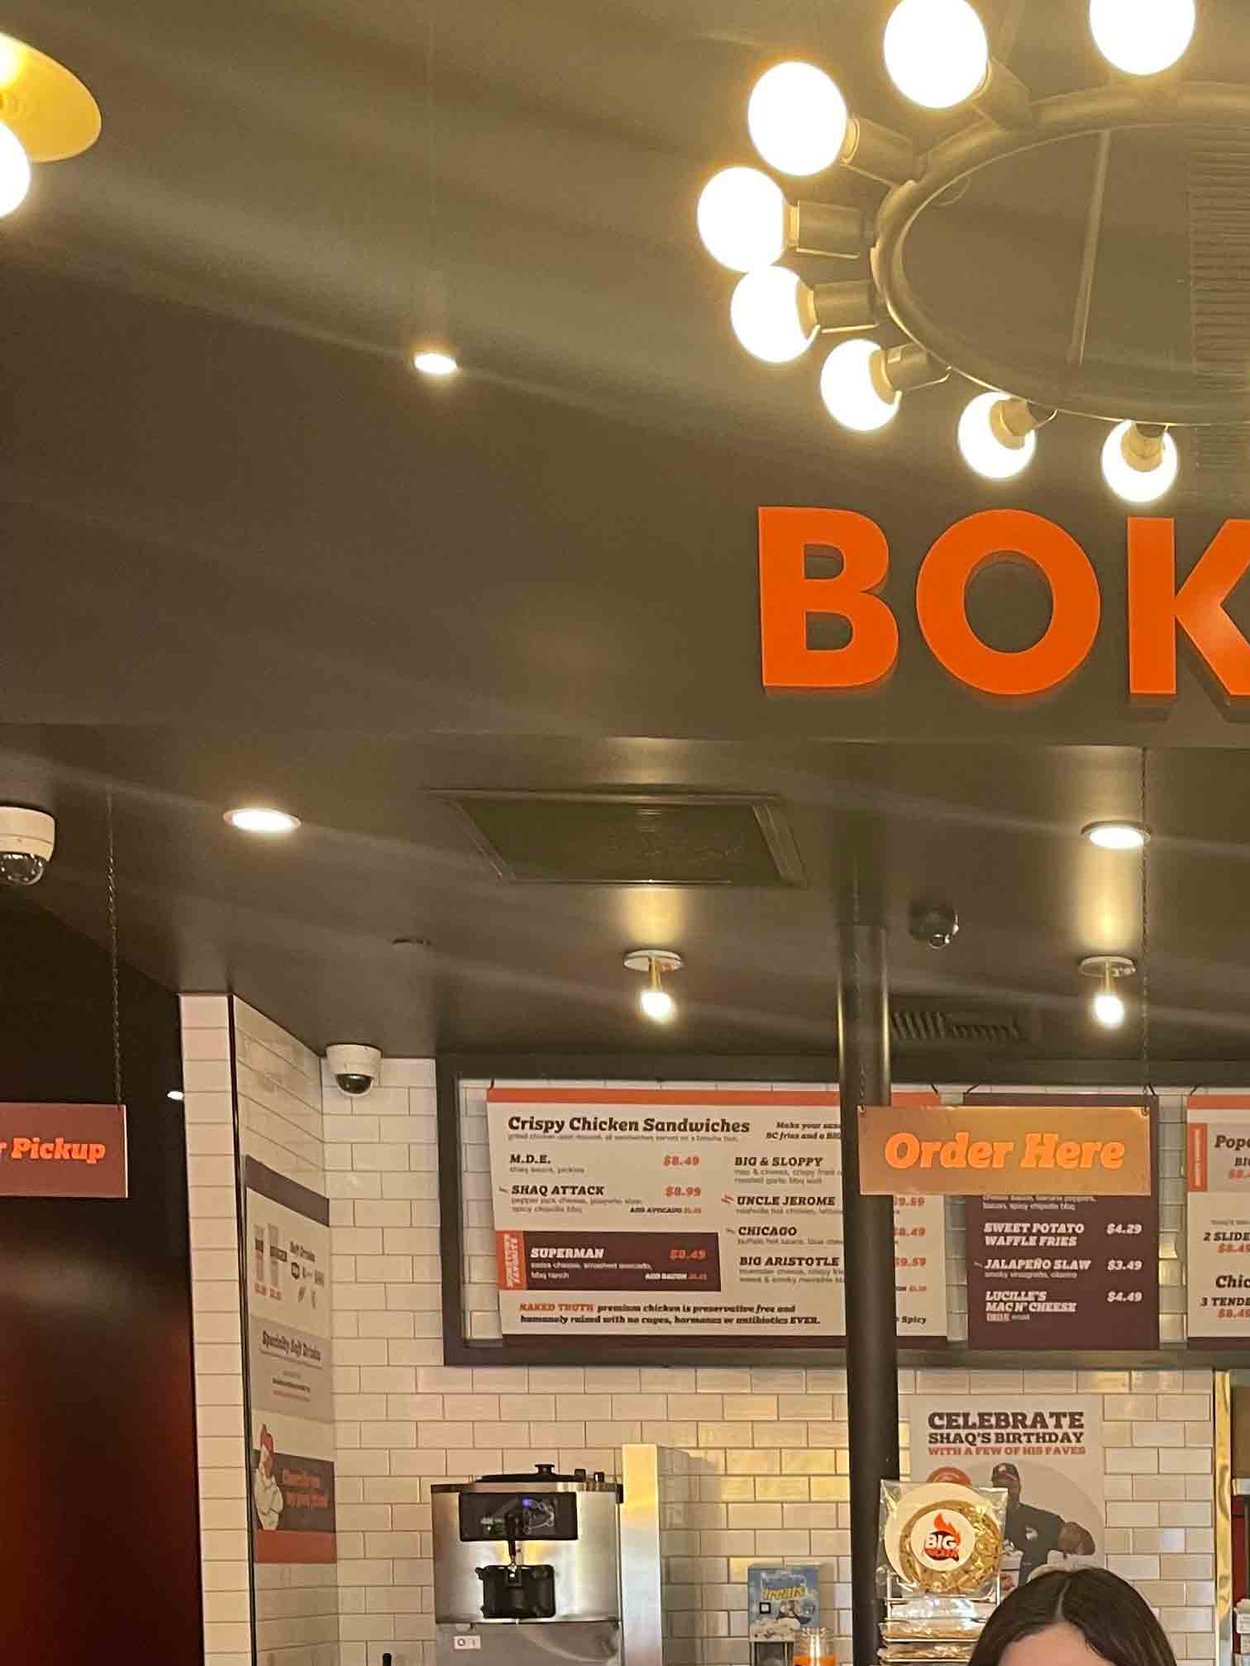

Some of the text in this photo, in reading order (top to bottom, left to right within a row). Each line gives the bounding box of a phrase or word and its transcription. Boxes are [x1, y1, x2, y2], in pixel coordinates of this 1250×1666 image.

[508, 1116, 750, 1134] Crispy Chicken Sandwiches
[11, 1137, 105, 1164] Pickup
[884, 1131, 1126, 1169] Order Here
[510, 1154, 699, 1166] M.D.E. $8.49
[735, 1157, 823, 1167] BIG & SLOPPY
[512, 1185, 701, 1198] SHAQ ATTACK $8.99
[737, 1196, 835, 1206] UNCLE JEROME
[738, 1226, 797, 1236] CHICAGO
[984, 1222, 1142, 1235] SWEET POTATO $4.29
[985, 1236, 1077, 1247] WAFFLE FRIES
[1204, 1232, 1211, 1241] 2
[531, 1248, 604, 1259] SUPERMAN
[740, 1257, 840, 1266] BIG ARISTOTLE
[984, 1257, 1142, 1271] JALAPEÑO SLAW $3.49
[985, 1291, 1142, 1303] LUCILLE'S $4.49
[1201, 1297, 1208, 1306] 3
[986, 1302, 1014, 1312] MAC
[1029, 1302, 1077, 1313] CHEESE
[928, 1411, 1084, 1430] CELEBRATE
[928, 1432, 1084, 1446] SHAQ'S BIRTHDAY
[928, 1447, 962, 1456] WITH
[964, 1447, 973, 1456] A
[975, 1447, 1003, 1456] FEW
[1004, 1447, 1022, 1456] OF
[925, 1534, 956, 1549] BIG
